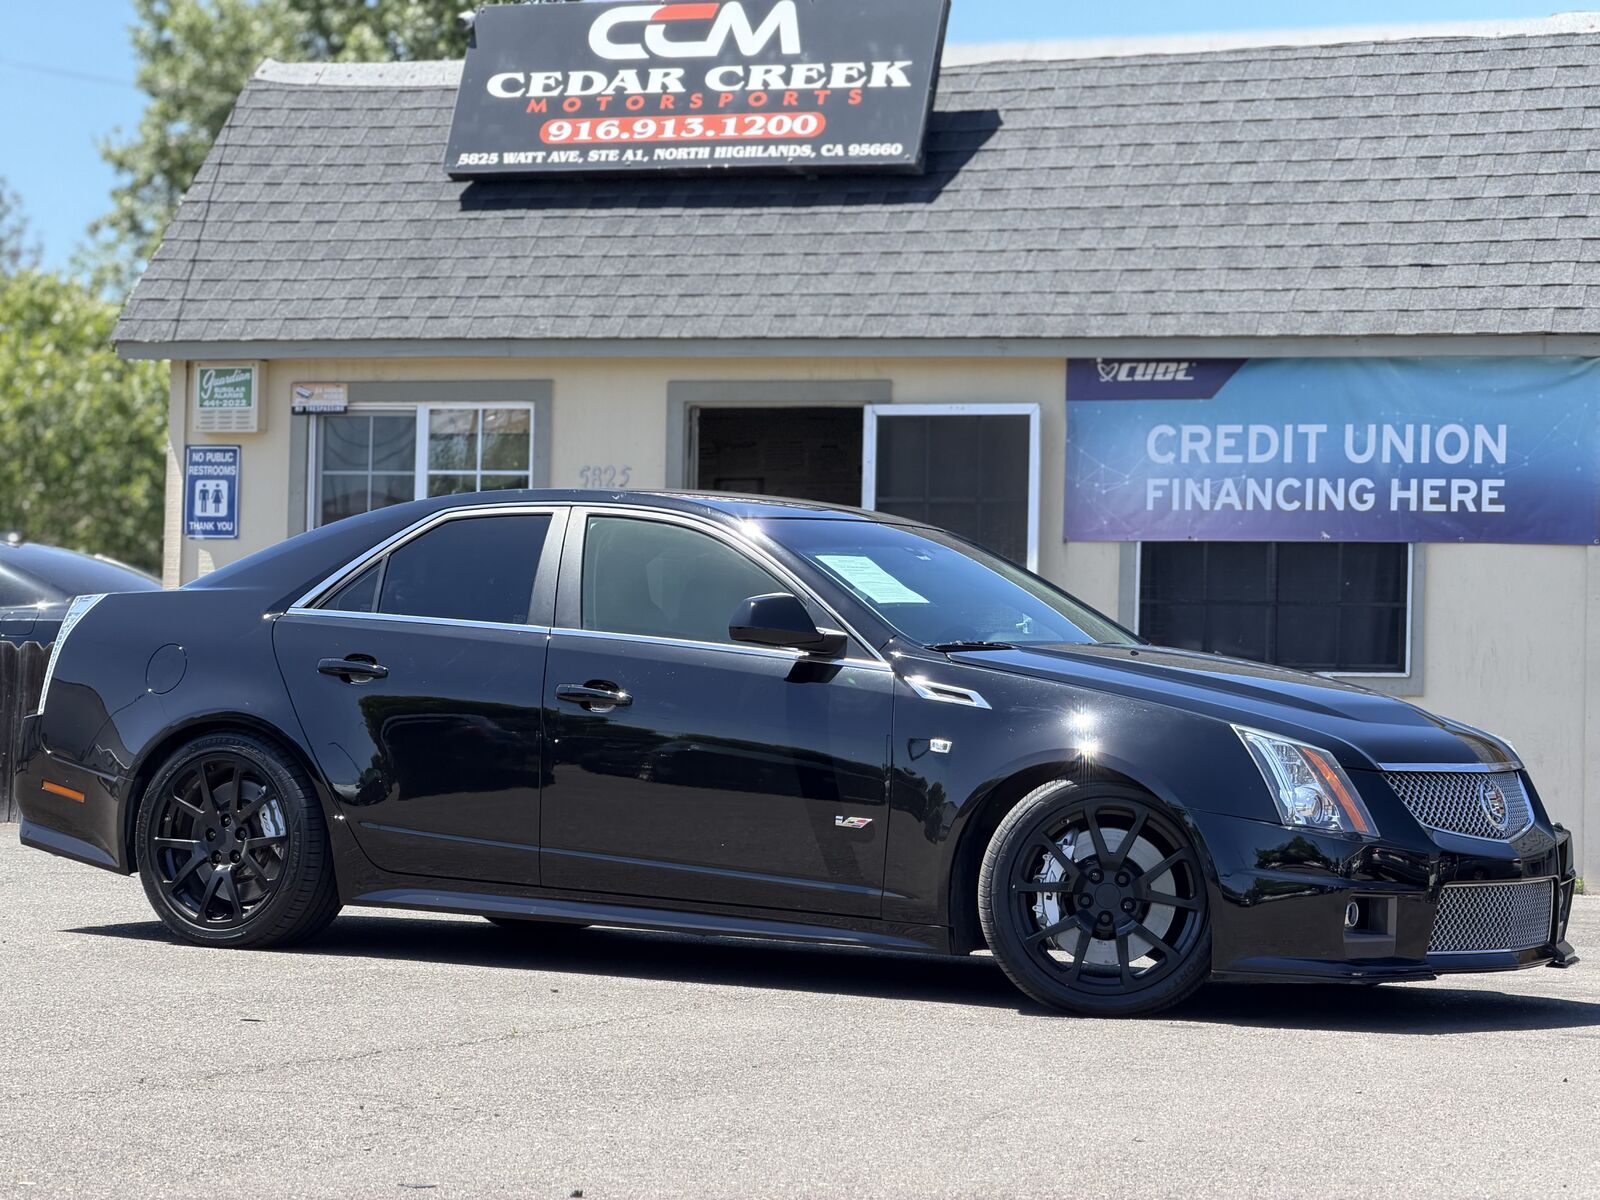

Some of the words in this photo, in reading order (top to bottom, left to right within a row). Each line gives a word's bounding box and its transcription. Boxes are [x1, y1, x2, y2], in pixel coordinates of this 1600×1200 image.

[588, 0, 801, 60] CCM
[486, 68, 686, 98] CEDAR
[704, 61, 914, 91] CREEK
[526, 88, 864, 113] MOTORSPORTS
[546, 114, 819, 141] 916.913.1200
[457, 153, 499, 165] 5825
[502, 151, 548, 165] WATT
[547, 150, 584, 164] AVE,
[587, 149, 619, 162] STE
[622, 149, 649, 162] A1,
[653, 146, 710, 160] NORTH
[713, 144, 816, 159] HIGHLANDS,
[820, 144, 844, 157] CA
[848, 143, 903, 156] 95660
[192, 452, 204, 462] NO
[206, 452, 234, 462] PUBLIC
[1146, 423, 1327, 466] CREDIT
[1343, 423, 1508, 465] UNION
[188, 465, 236, 476] RESTROOMS
[1146, 477, 1375, 512] FINANCING
[1390, 478, 1506, 513] HERE
[189, 521, 214, 530] THANK
[217, 521, 233, 531] YOU
